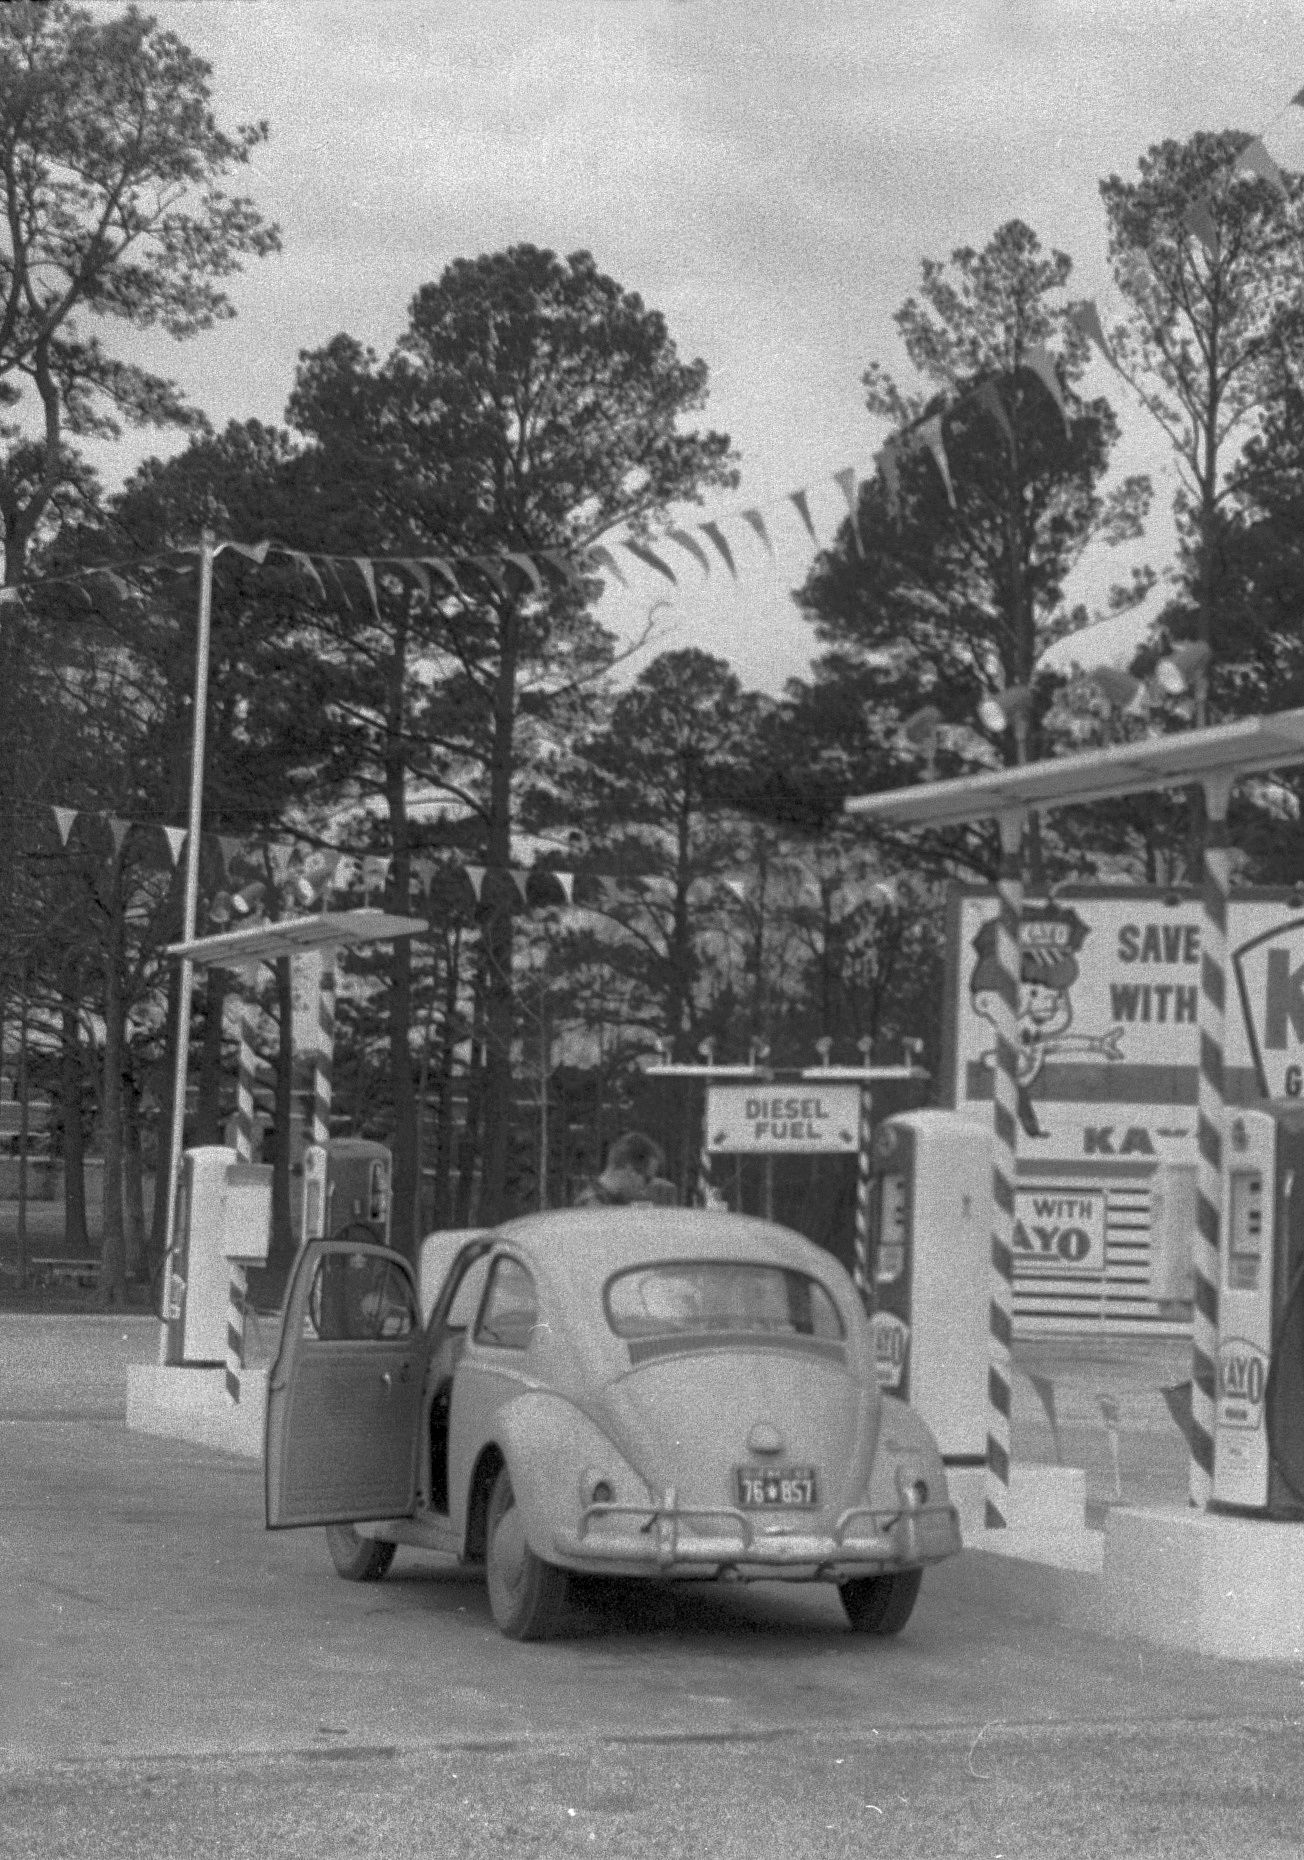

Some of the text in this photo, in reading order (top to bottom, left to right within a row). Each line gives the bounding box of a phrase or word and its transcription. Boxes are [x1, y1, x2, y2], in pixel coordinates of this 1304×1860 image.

[1118, 924, 1200, 963] SAVE
[1109, 983, 1198, 1023] WITH
[746, 1099, 829, 1120] DIESEL
[755, 1122, 822, 1139] FUEL
[1033, 1199, 1093, 1219] WITH
[1011, 1219, 1091, 1262] AYO
